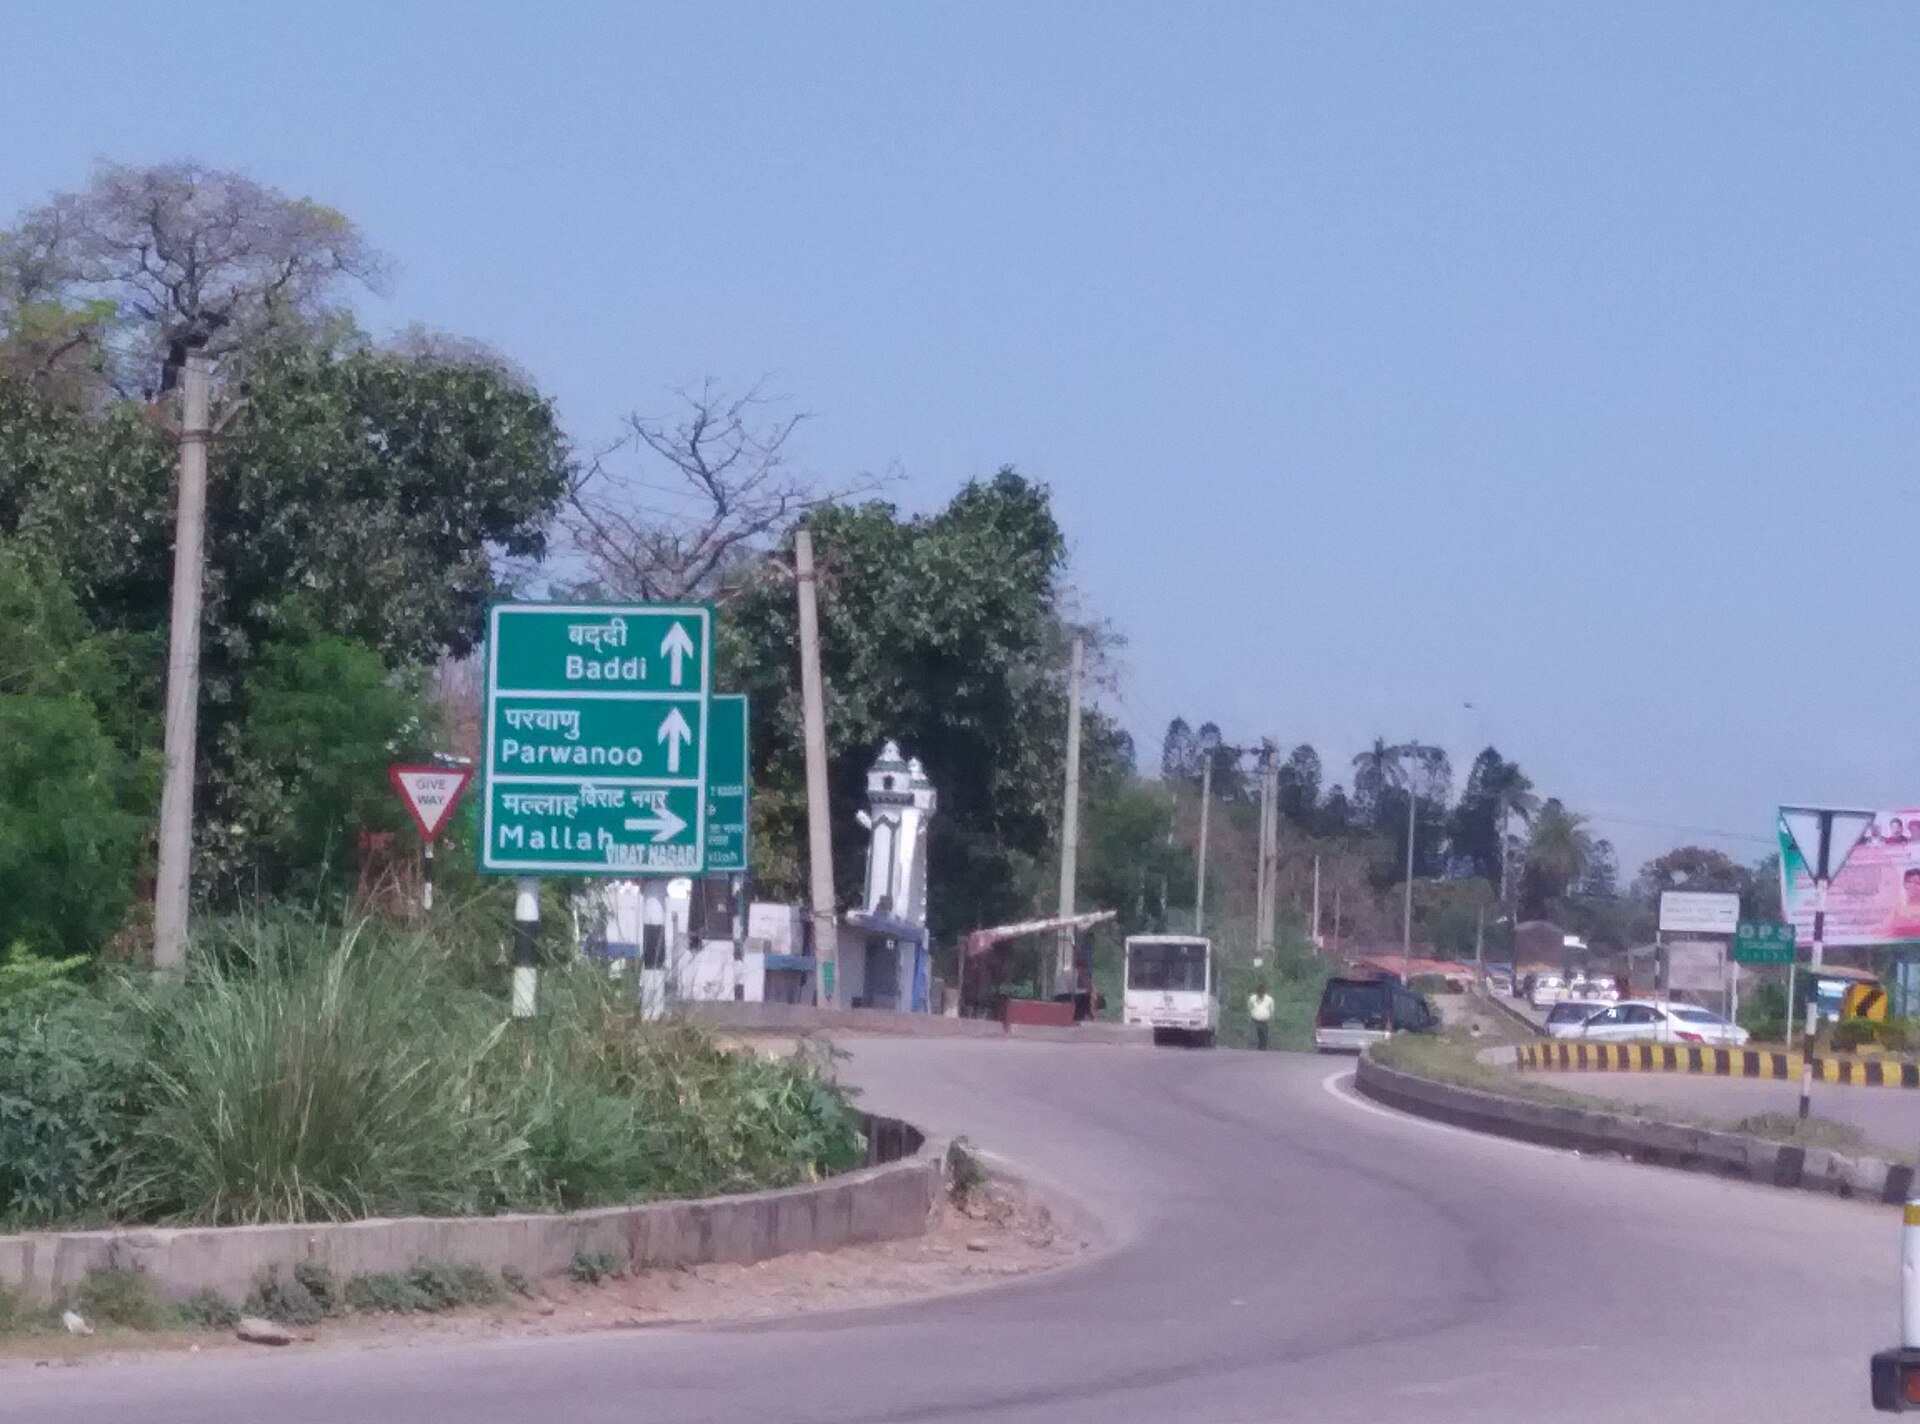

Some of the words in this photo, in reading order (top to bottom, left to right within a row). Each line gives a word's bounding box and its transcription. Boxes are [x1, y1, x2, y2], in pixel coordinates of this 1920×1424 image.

[566, 655, 647, 680] Baddi
[504, 709, 581, 740] परवाणु
[501, 739, 643, 766] Parwanoo
[416, 779, 447, 790] GIVE
[417, 795, 445, 805] WAY
[501, 793, 579, 819] मल्लाह
[579, 784, 625, 808] विराट
[631, 790, 668, 808] नगर
[499, 824, 614, 851] Mallah
[606, 844, 647, 865] VIRAT
[648, 844, 697, 867] NAGAR
